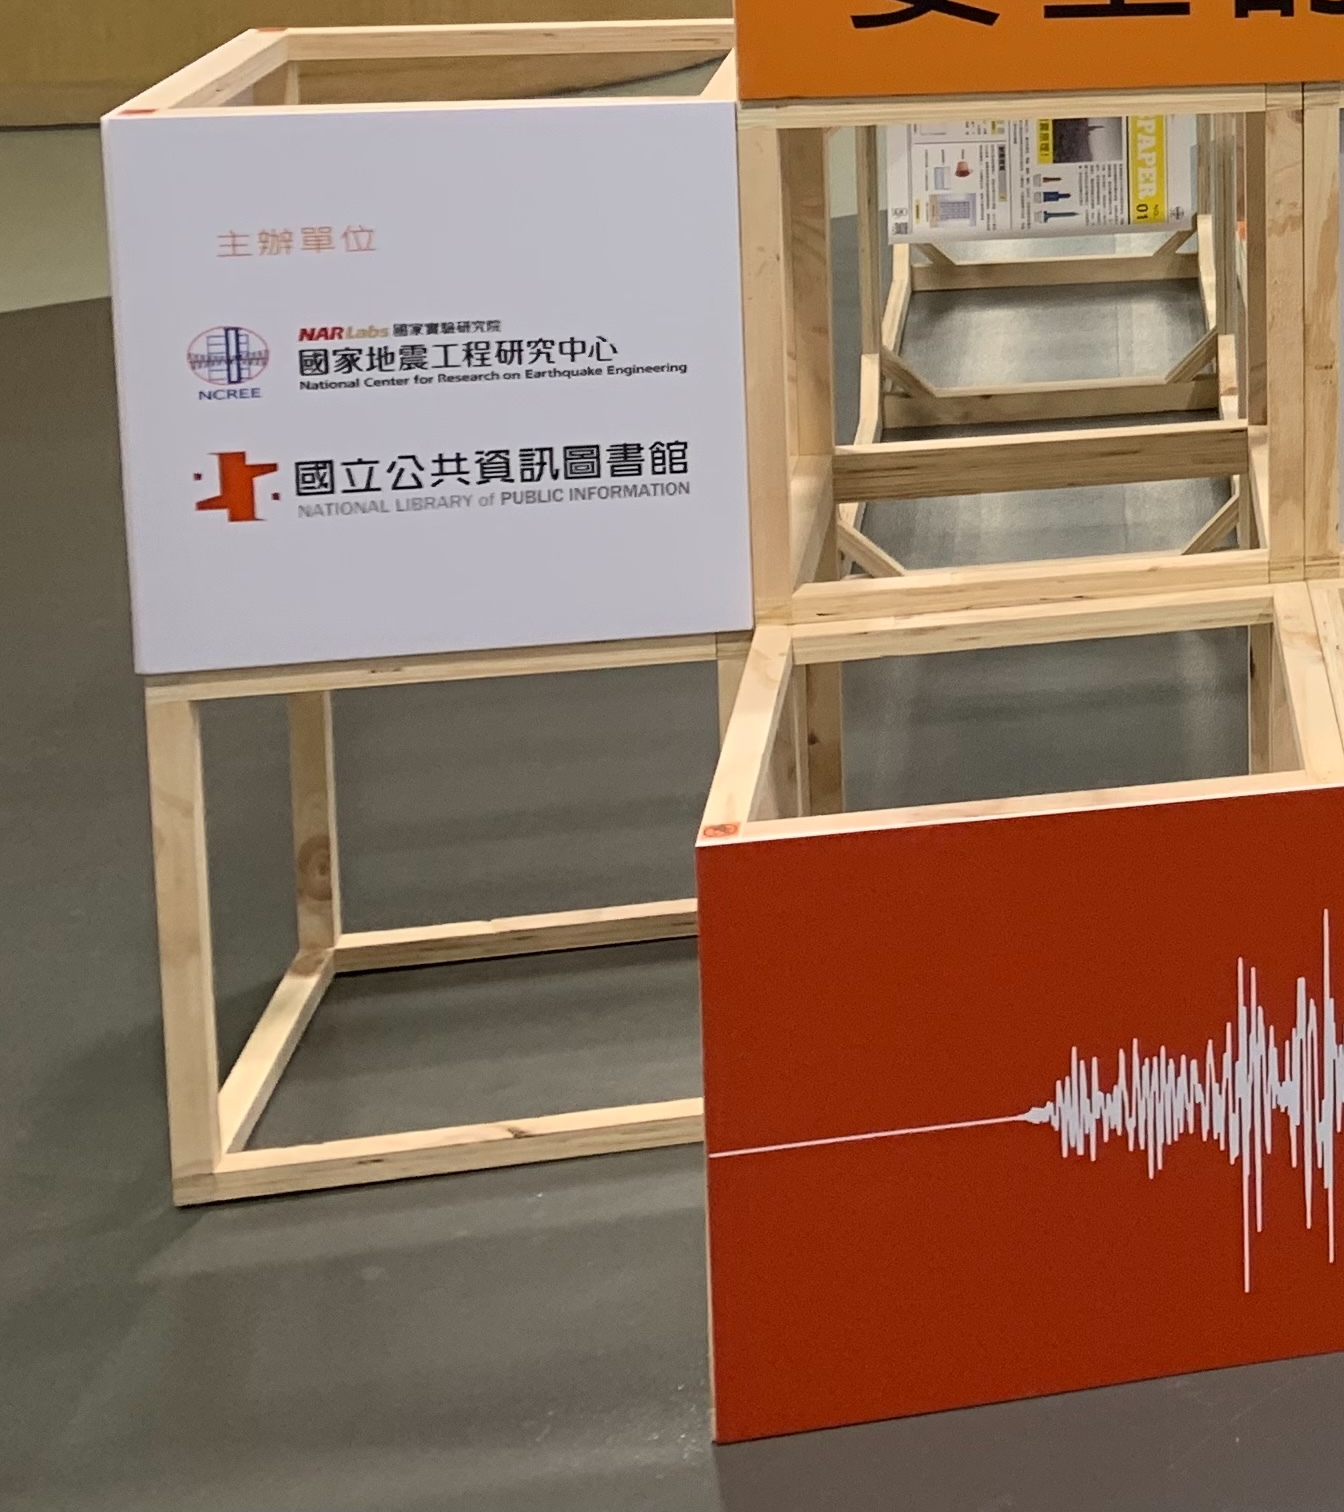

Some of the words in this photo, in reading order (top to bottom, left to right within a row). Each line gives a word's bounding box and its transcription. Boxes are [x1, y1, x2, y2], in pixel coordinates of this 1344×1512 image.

[1136, 116, 1157, 200] PAPER
[216, 225, 377, 257] 主辦單位
[392, 320, 501, 337] 國家實驗研究院
[298, 335, 618, 376] 國家地震工程研究中心
[300, 377, 360, 390] National
[364, 375, 409, 387] Center
[414, 374, 433, 384] for
[438, 371, 500, 383] Research
[503, 372, 521, 380] on
[525, 366, 602, 380] Earthquake
[607, 363, 688, 376] Engineering
[198, 388, 262, 401] NCREE
[294, 440, 689, 497] 國立公共資訊圖書館
[298, 499, 390, 518] NATIONAL
[395, 494, 473, 512] LIBRARY
[478, 493, 495, 506] of
[501, 488, 564, 505] PUBLIC
[569, 482, 691, 501] INFORMATION
